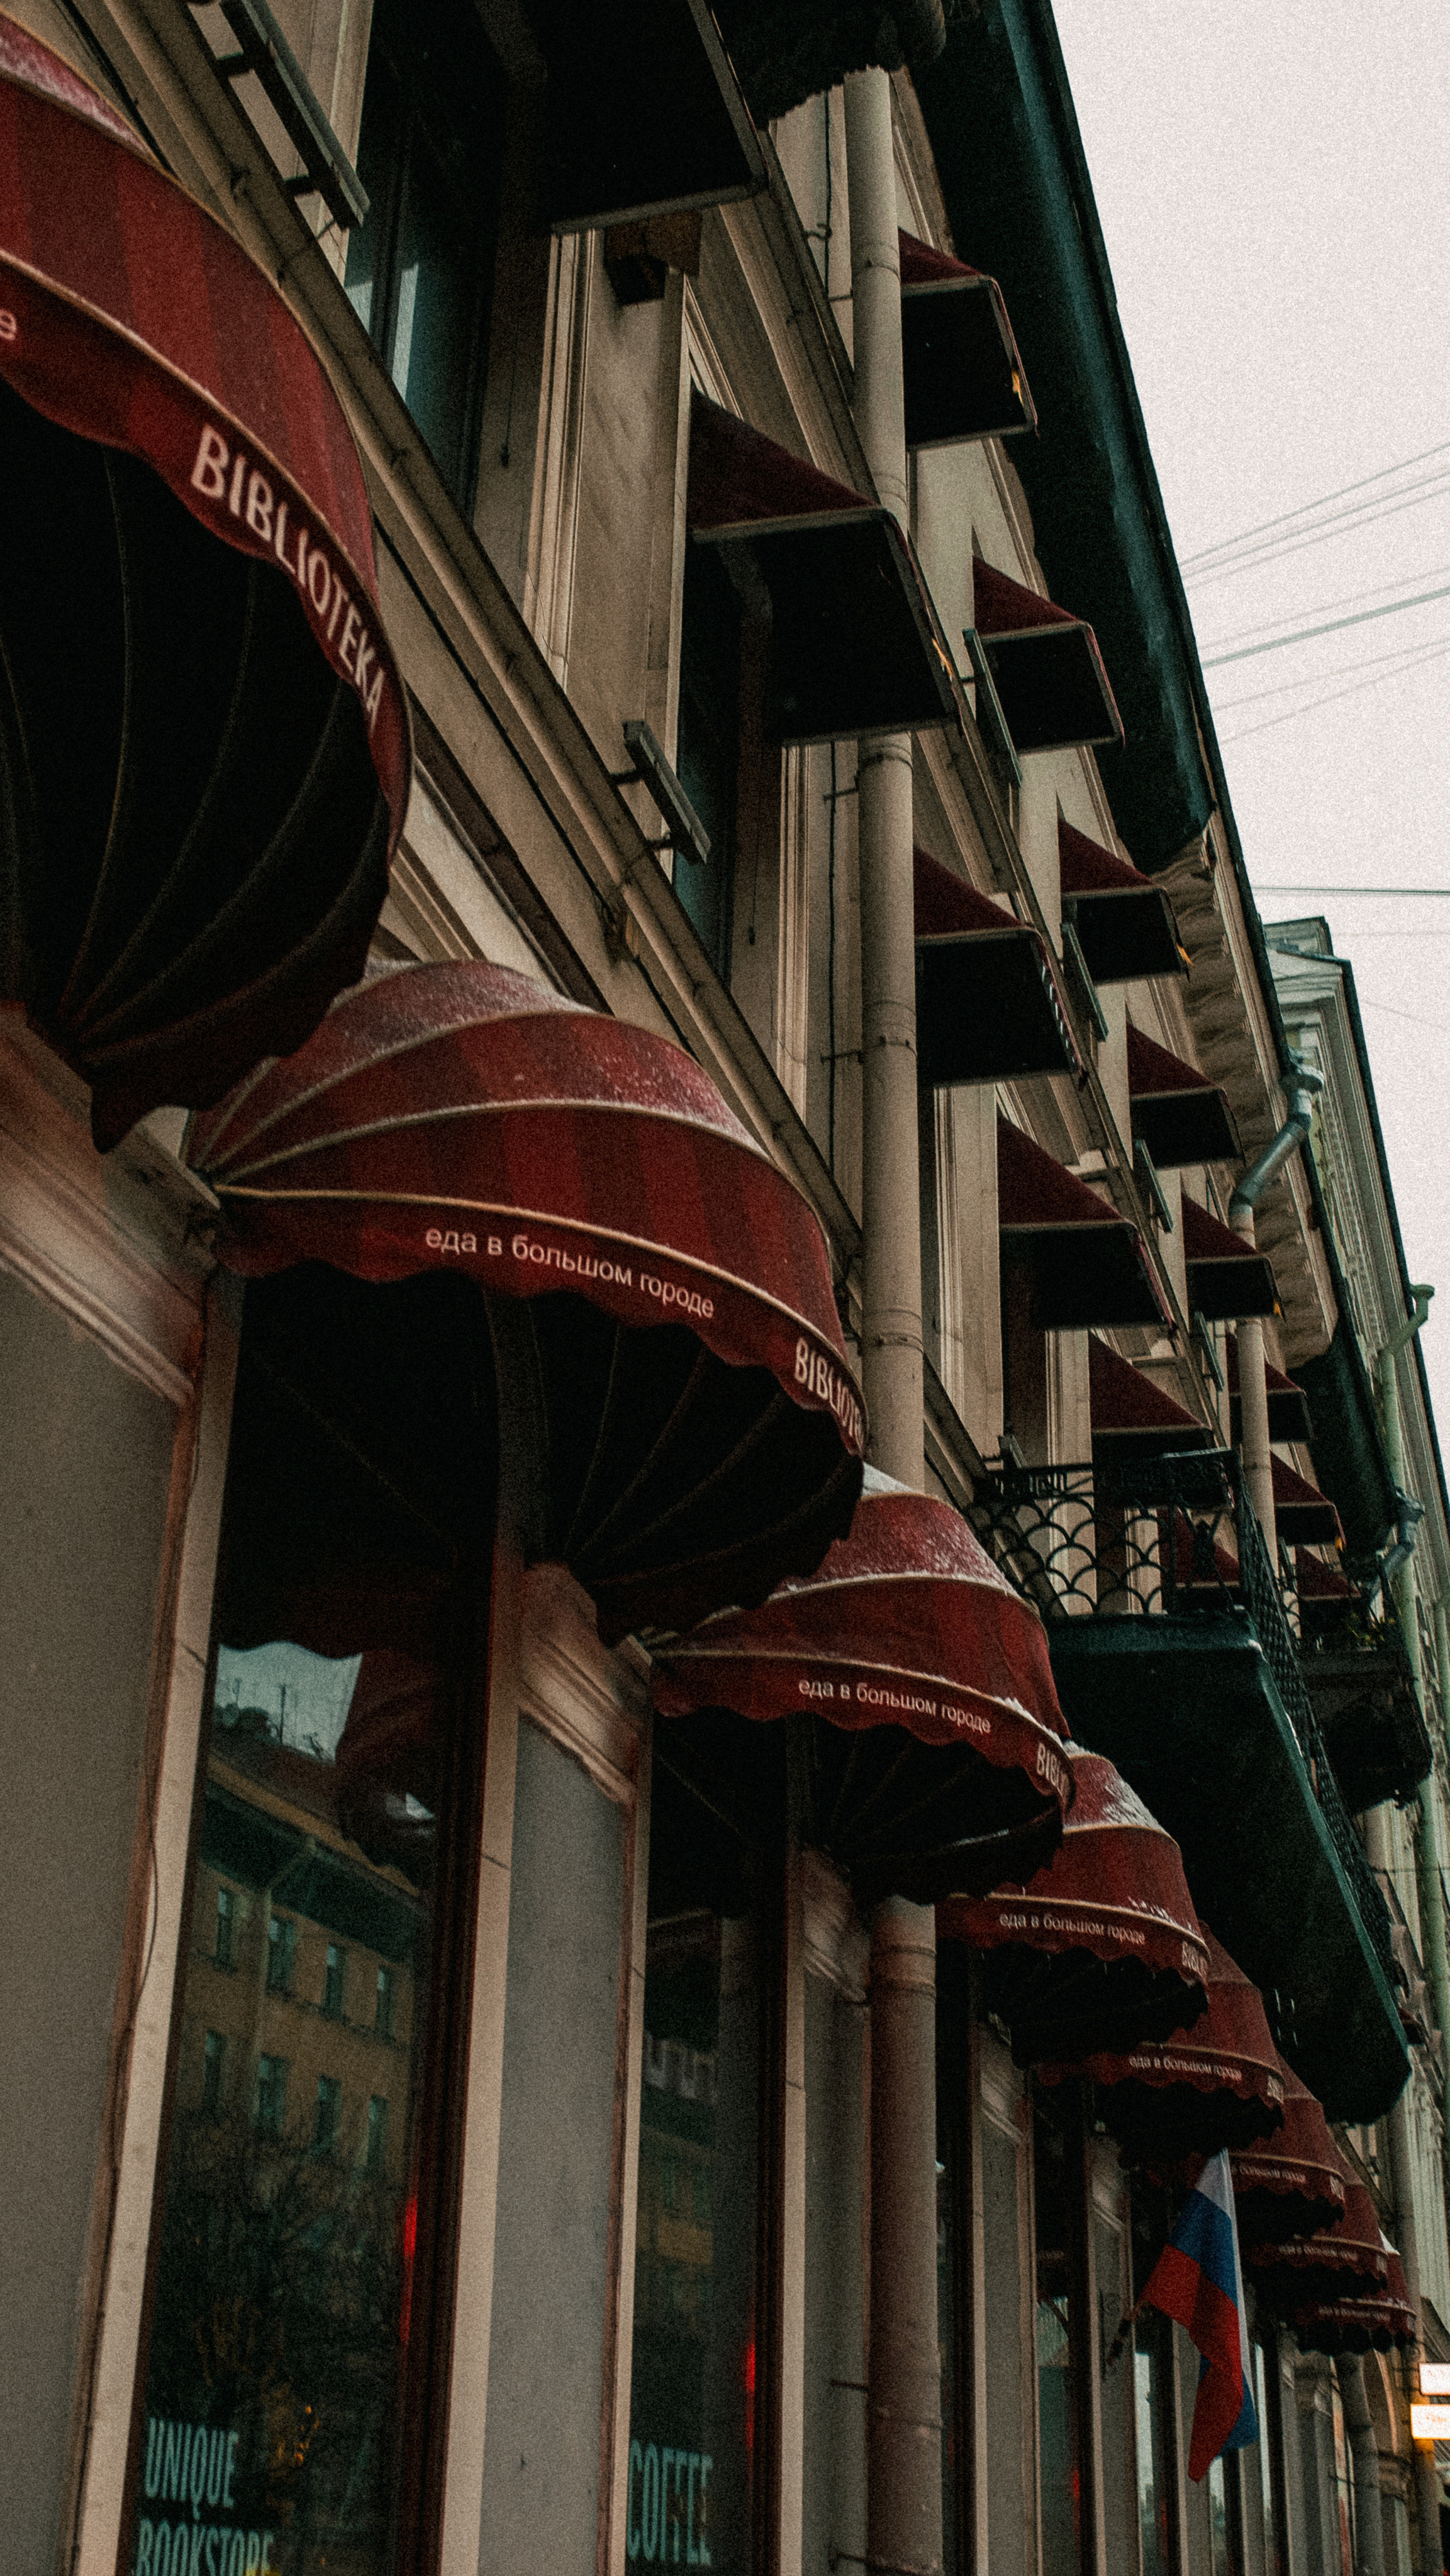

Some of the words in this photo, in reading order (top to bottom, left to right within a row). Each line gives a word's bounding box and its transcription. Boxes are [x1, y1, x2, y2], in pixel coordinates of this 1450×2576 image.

[191, 424, 385, 733] BIBLIOTEKA
[425, 1228, 477, 1255] еда
[487, 1235, 503, 1256] в
[511, 1234, 632, 1287] большом
[640, 1273, 714, 1318] городе
[798, 1679, 834, 1699] еда
[840, 1683, 850, 1699] в
[857, 1682, 937, 1716] большом
[942, 1704, 991, 1735] городе
[1044, 1913, 1105, 1936] большом
[145, 2418, 239, 2519] UNIQUE
[627, 2438, 713, 2566] COFFEE
[136, 2518, 274, 2576] BOOKSTORE
